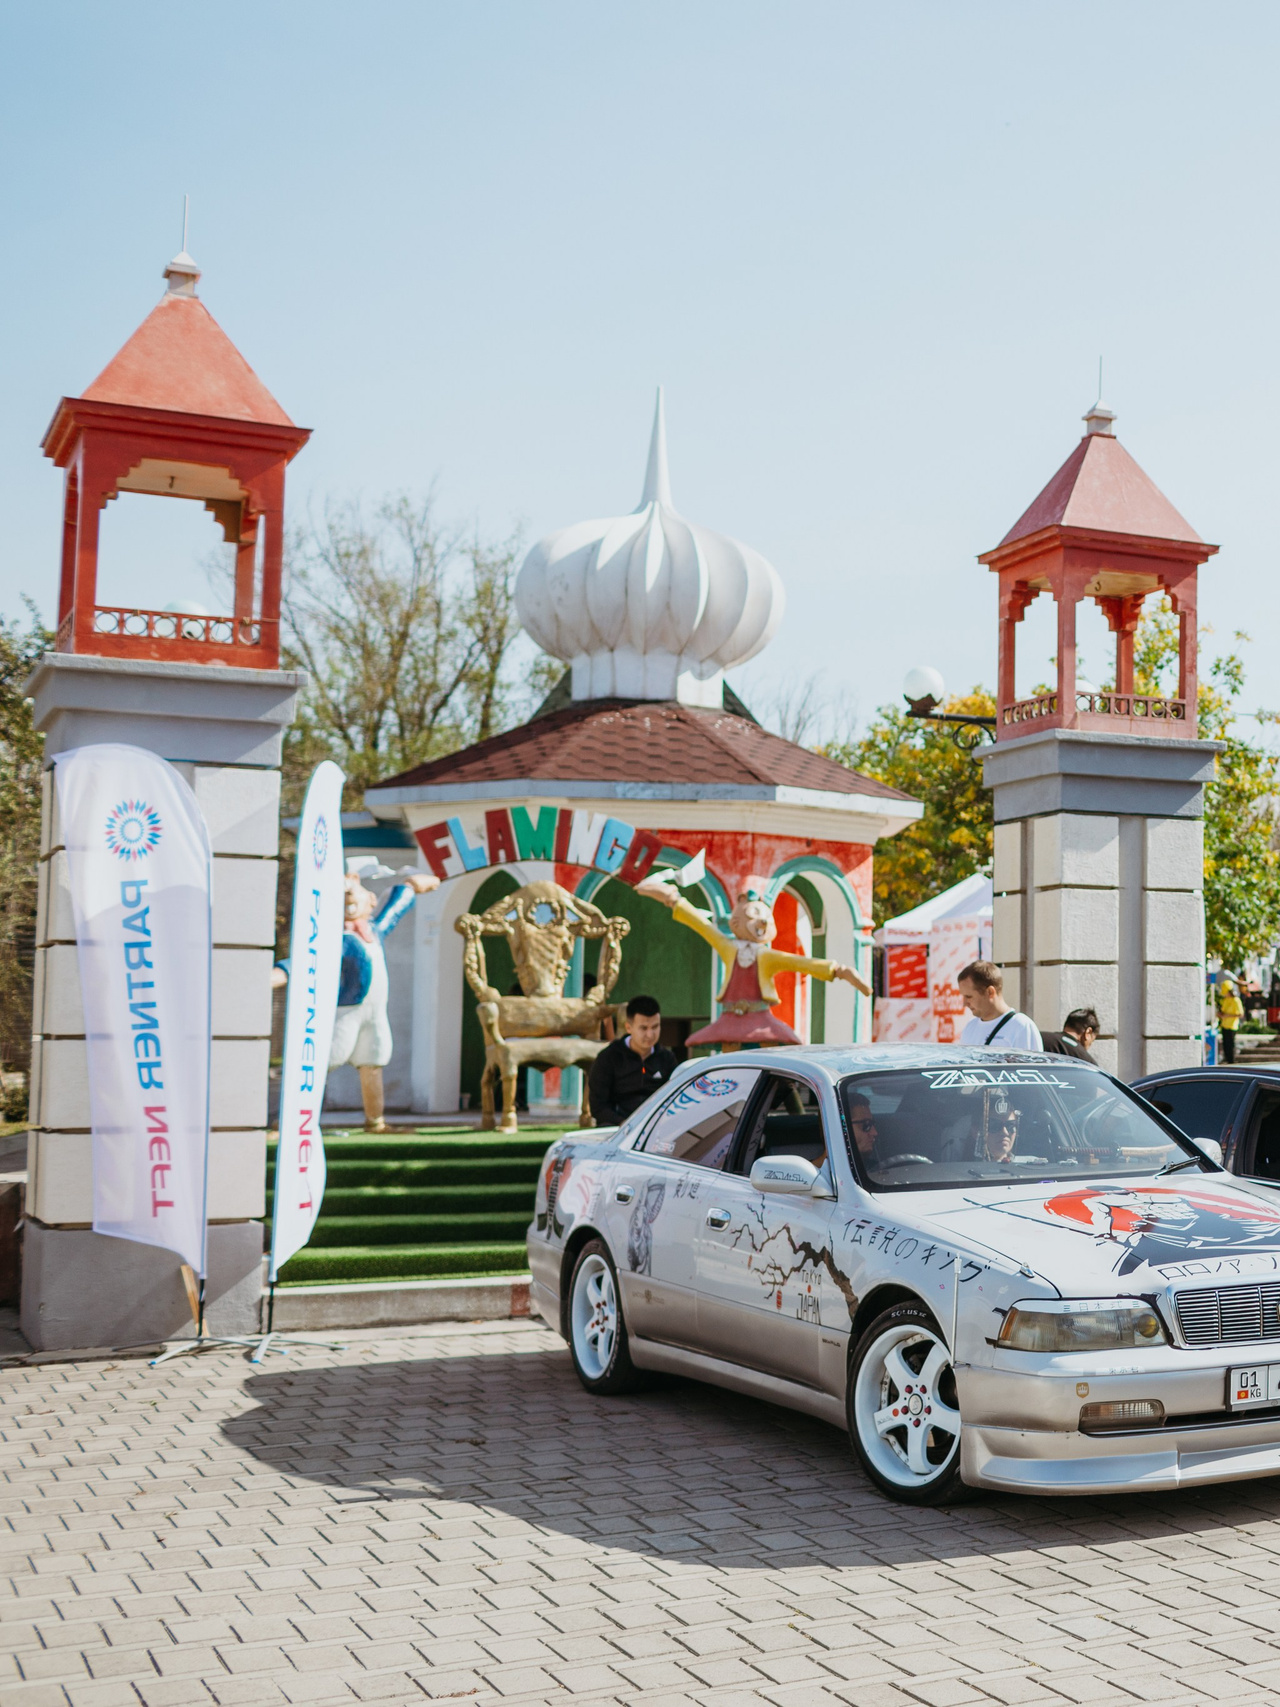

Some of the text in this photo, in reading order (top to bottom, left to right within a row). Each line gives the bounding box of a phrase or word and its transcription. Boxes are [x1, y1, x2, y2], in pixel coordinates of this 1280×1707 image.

[414, 806, 664, 885] FLAMINGO
[299, 889, 321, 1092] PARTNER
[796, 1293, 821, 1325] JAPAN
[1240, 1371, 1258, 1389] 01
[1250, 1388, 1262, 1398] KG
